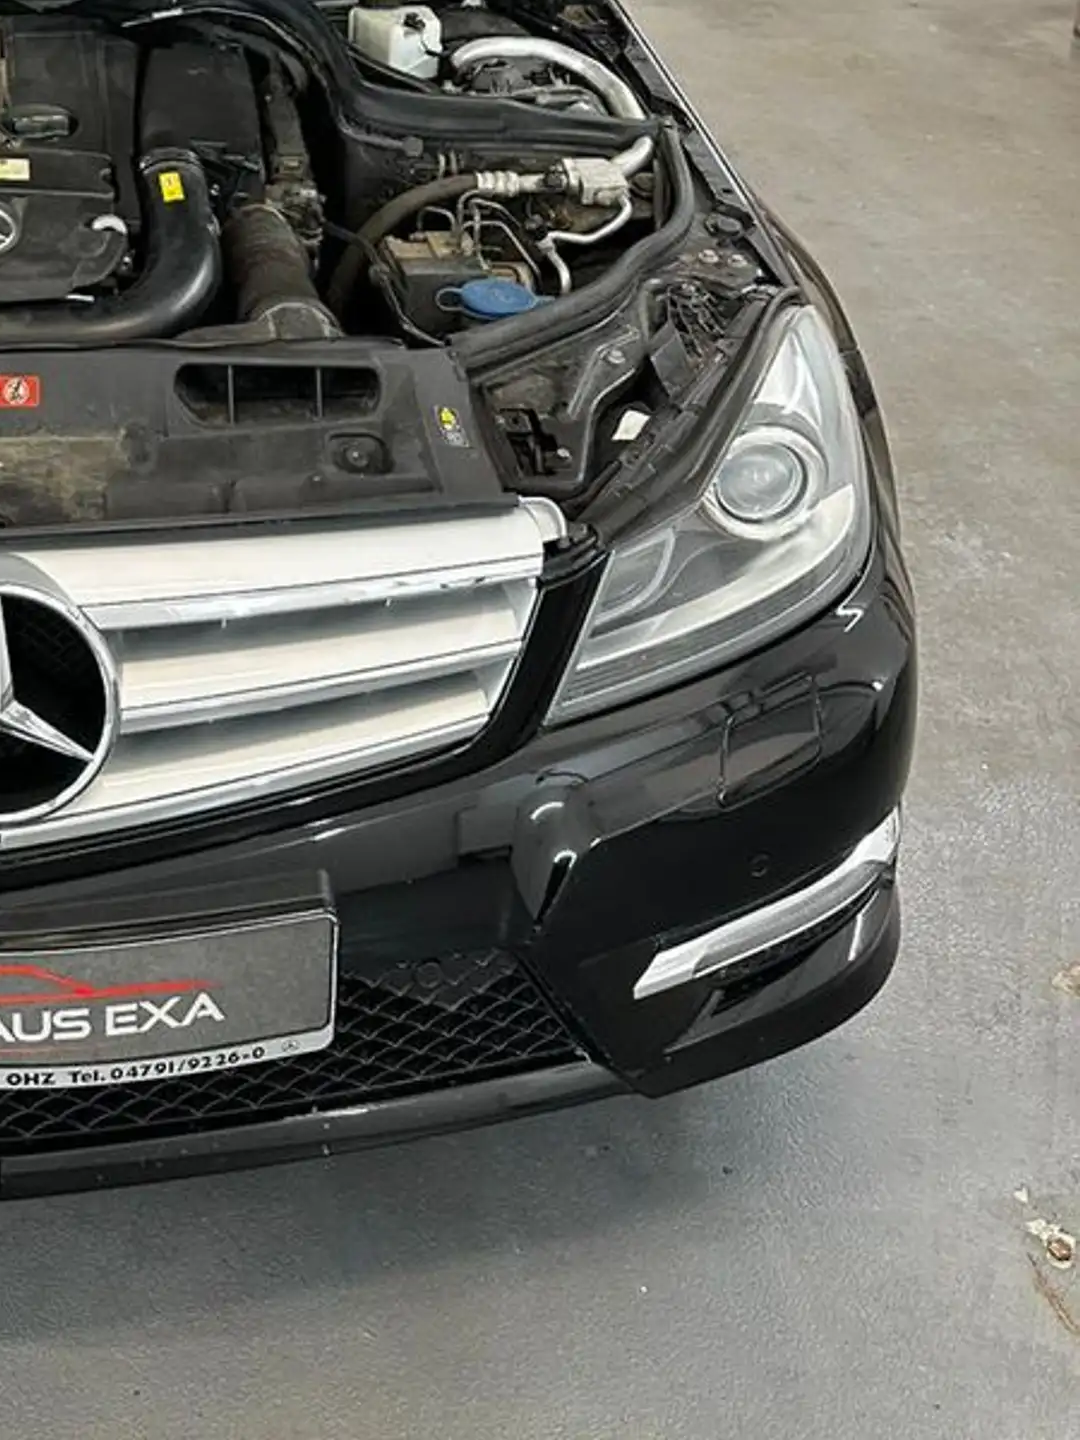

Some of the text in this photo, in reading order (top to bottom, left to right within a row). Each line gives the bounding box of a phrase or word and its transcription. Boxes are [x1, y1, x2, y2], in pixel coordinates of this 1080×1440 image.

[105, 991, 225, 1036] EXA
[6, 1071, 57, 1086] OHZ
[69, 1070, 106, 1084] Tel.
[110, 1046, 266, 1080] 04791/9226-0
